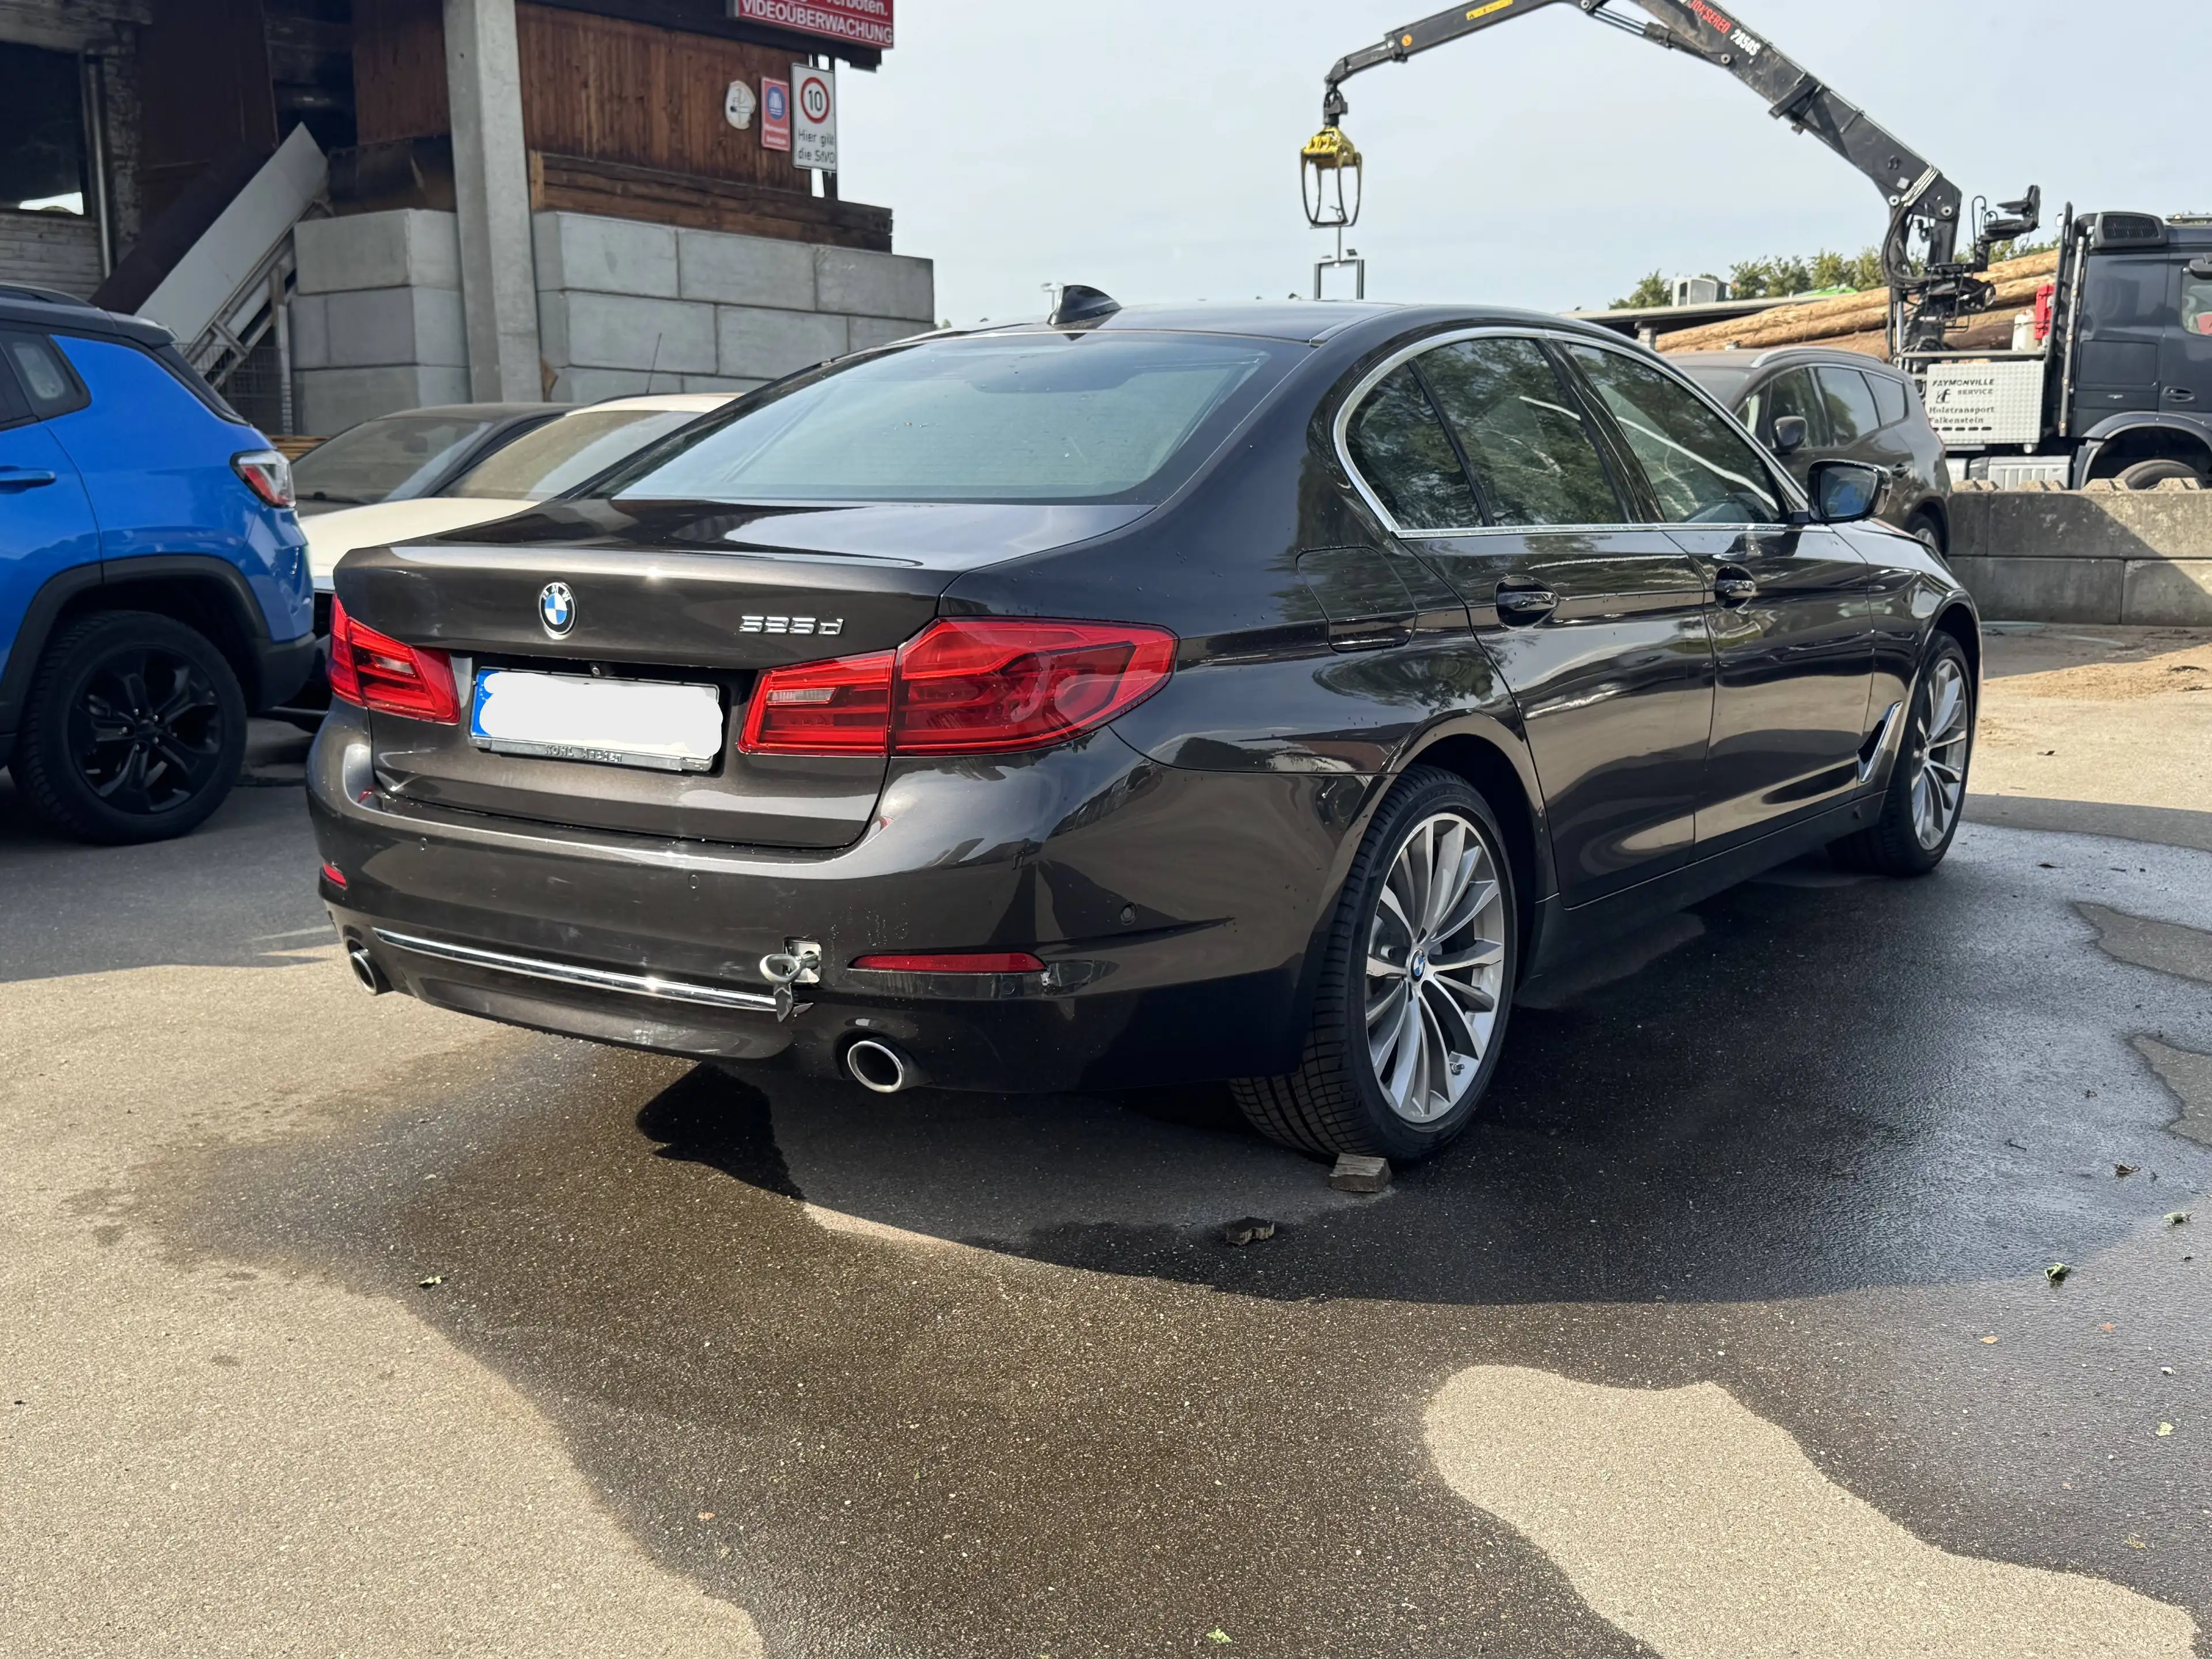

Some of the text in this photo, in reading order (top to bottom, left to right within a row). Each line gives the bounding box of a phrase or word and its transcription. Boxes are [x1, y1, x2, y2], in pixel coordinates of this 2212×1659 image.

[826, 0, 888, 16] rboten.
[741, 0, 893, 43] VIDEOÜBERWACHUNG
[808, 90, 823, 112] 10
[798, 129, 817, 142] Hier
[798, 147, 812, 161] die
[1932, 378, 1995, 387] FAYMONVILLE
[739, 615, 844, 635] 525d
